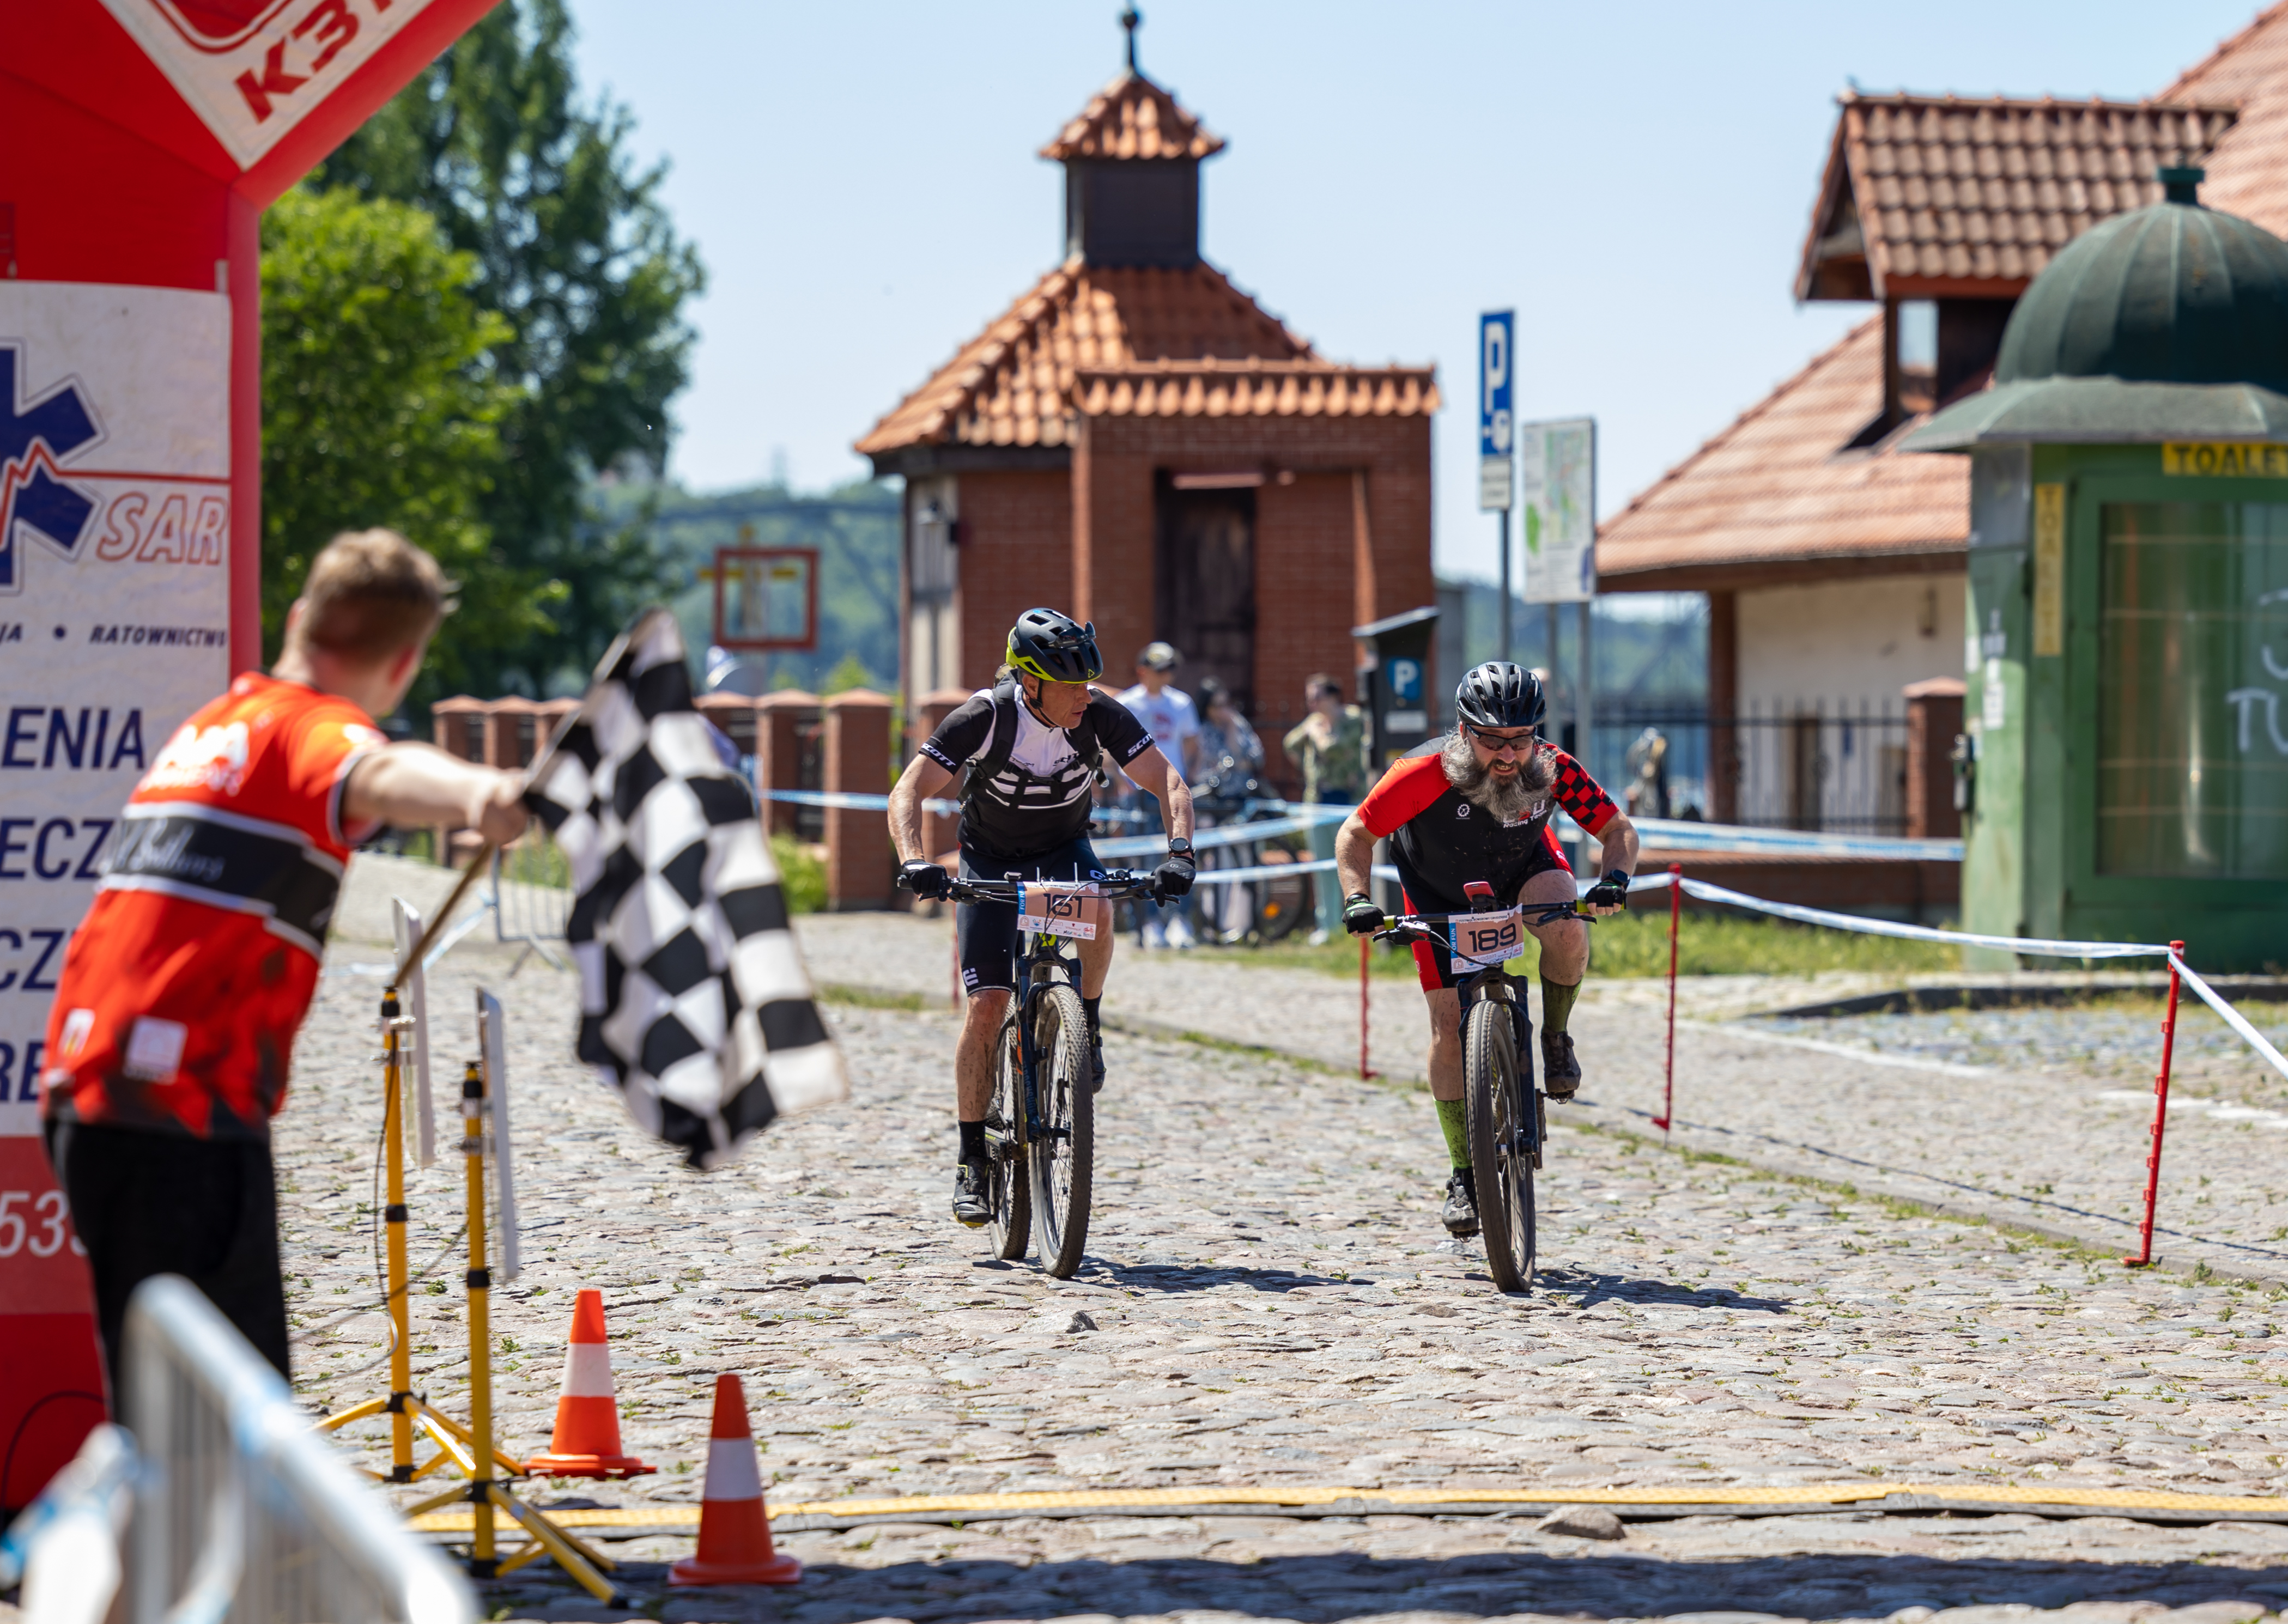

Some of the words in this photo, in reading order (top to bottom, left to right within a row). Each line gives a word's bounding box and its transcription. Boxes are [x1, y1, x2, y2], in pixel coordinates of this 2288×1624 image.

[233, 0, 393, 125] K3
[2171, 444, 2288, 478] TOALE
[96, 491, 229, 565] SAR
[921, 743, 956, 767] SCOTT
[1503, 819, 1528, 829] Racing
[1530, 810, 1547, 822] Team
[1043, 893, 1083, 919] 161
[1468, 922, 1516, 953] 189
